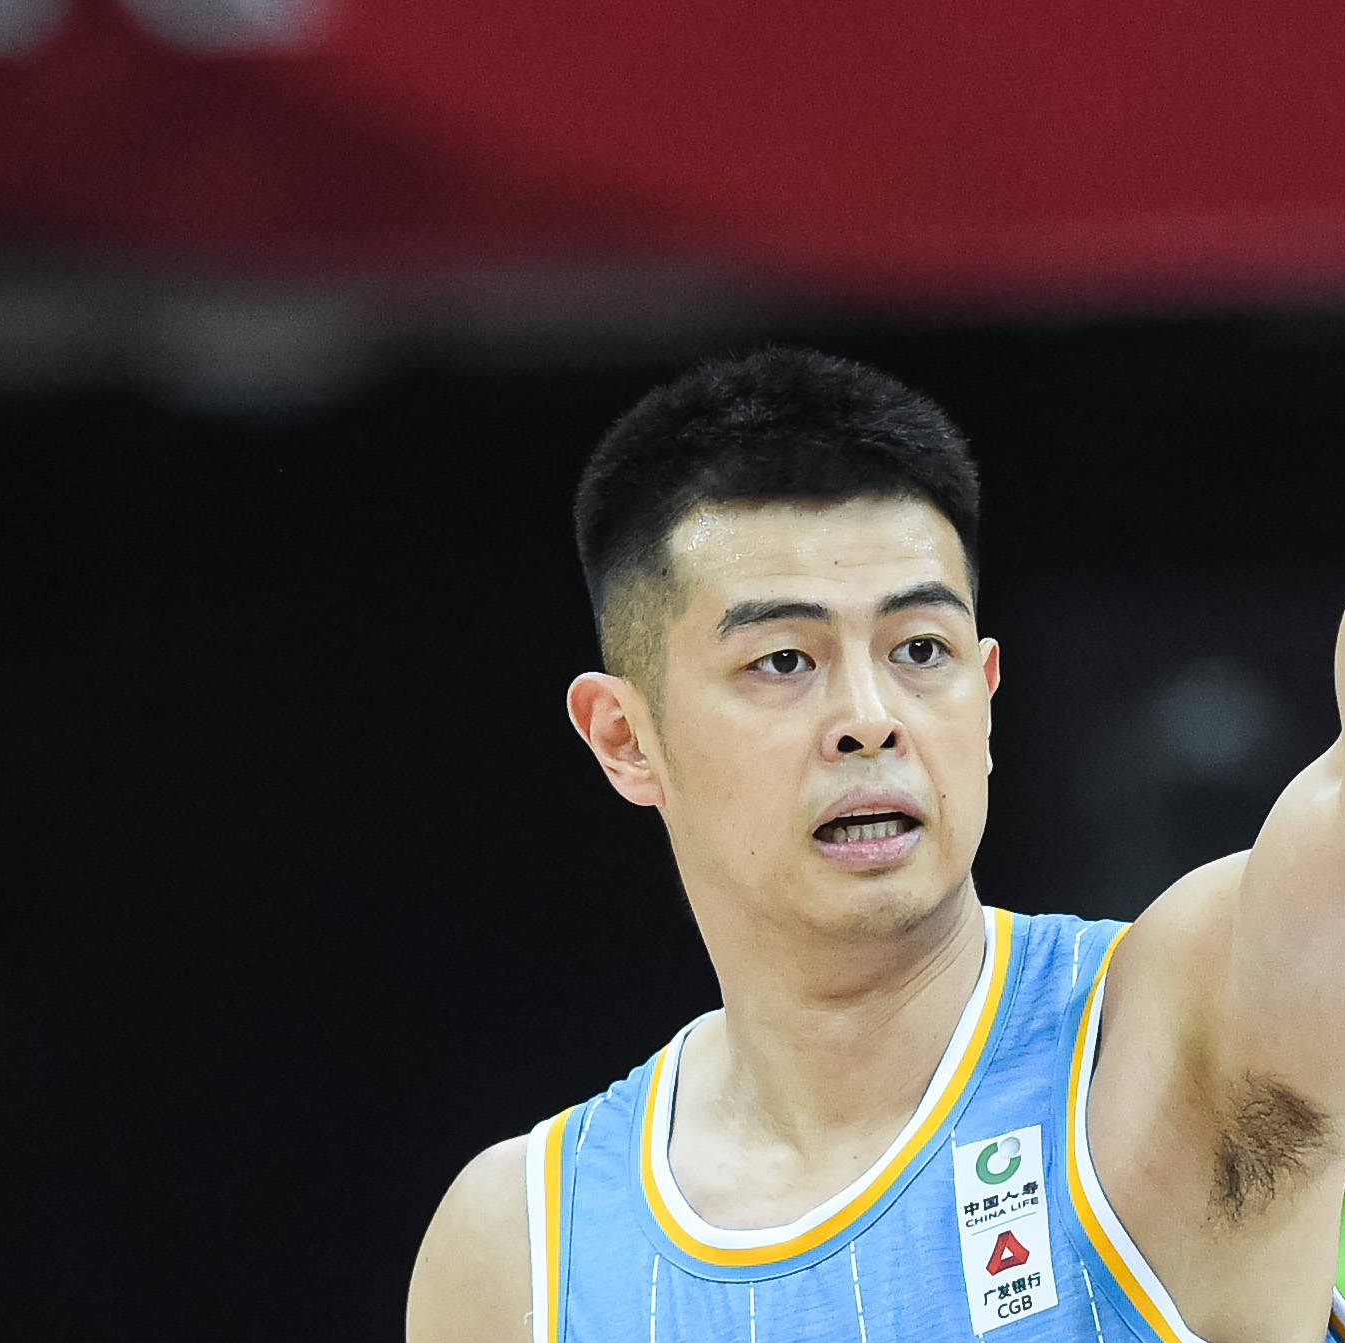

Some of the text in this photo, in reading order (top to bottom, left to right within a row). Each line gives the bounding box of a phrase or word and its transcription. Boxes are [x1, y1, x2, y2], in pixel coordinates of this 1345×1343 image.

[963, 1180, 1039, 1216] 中国人寿
[965, 1196, 1039, 1228] CHINA LIFE
[983, 1271, 1041, 1307] 广发银行
[997, 1294, 1033, 1319] CGB
